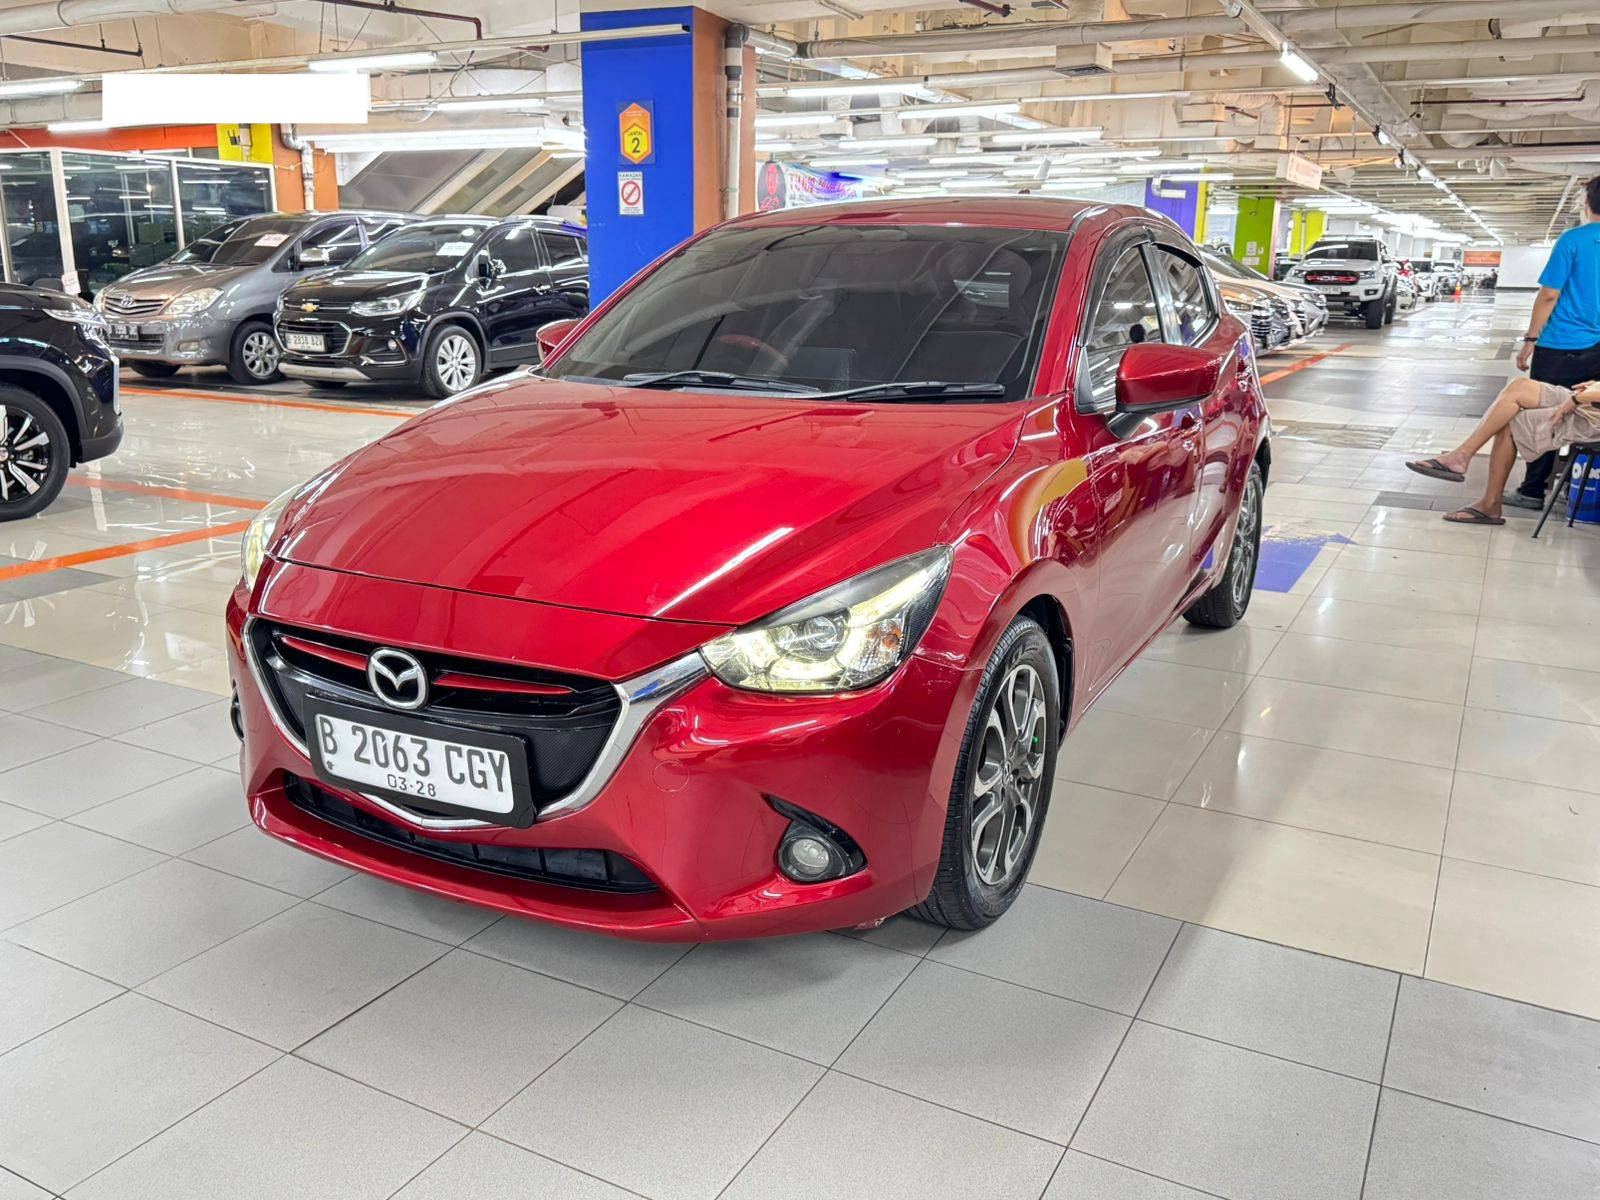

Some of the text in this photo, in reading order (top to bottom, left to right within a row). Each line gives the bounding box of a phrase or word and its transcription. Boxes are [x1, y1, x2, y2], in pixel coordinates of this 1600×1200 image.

[631, 137, 641, 153] 2
[319, 716, 506, 793] B 2063 CGY
